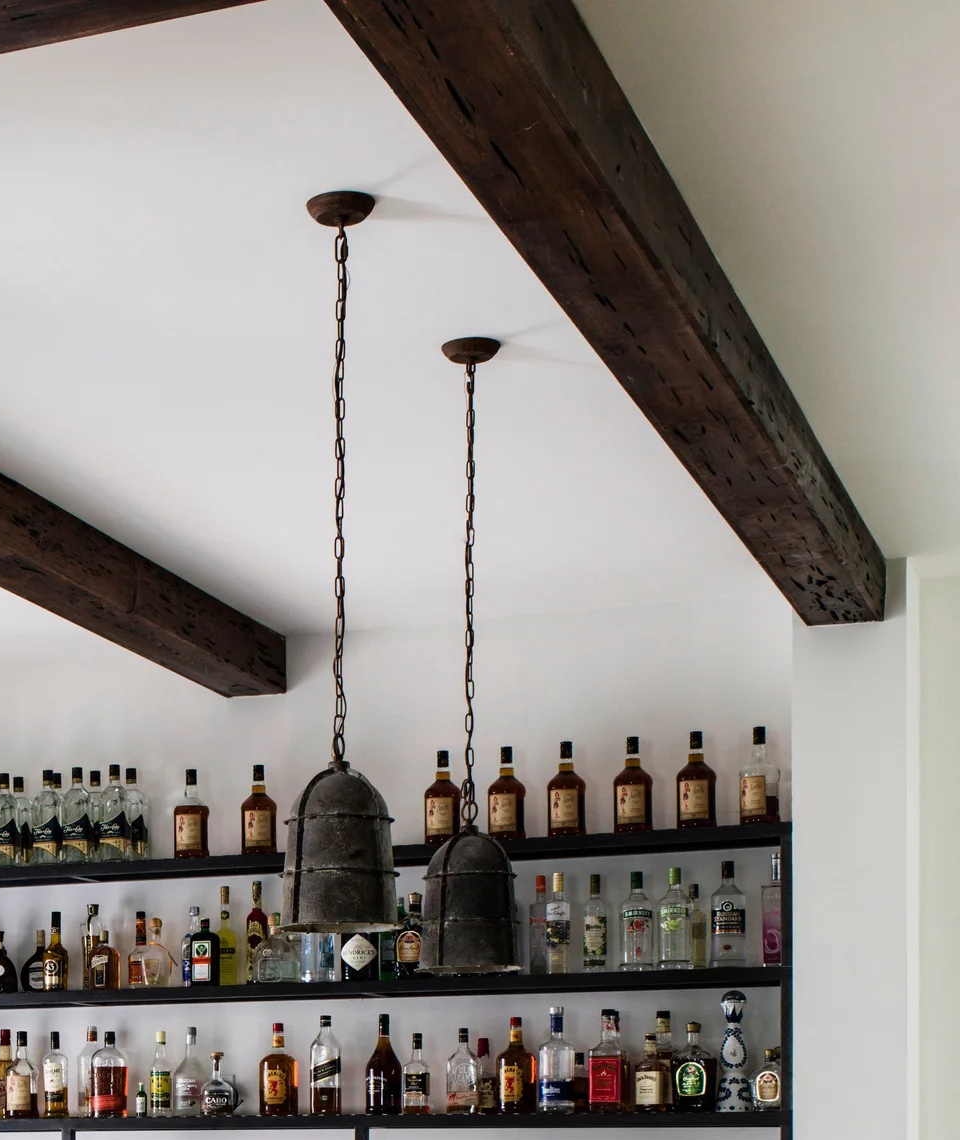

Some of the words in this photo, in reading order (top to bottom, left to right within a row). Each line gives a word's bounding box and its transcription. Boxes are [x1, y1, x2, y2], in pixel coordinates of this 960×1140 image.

[623, 910, 651, 918] SMIRNOFF
[661, 907, 687, 915] SMIRNOFF
[205, 1096, 228, 1104] CABO
